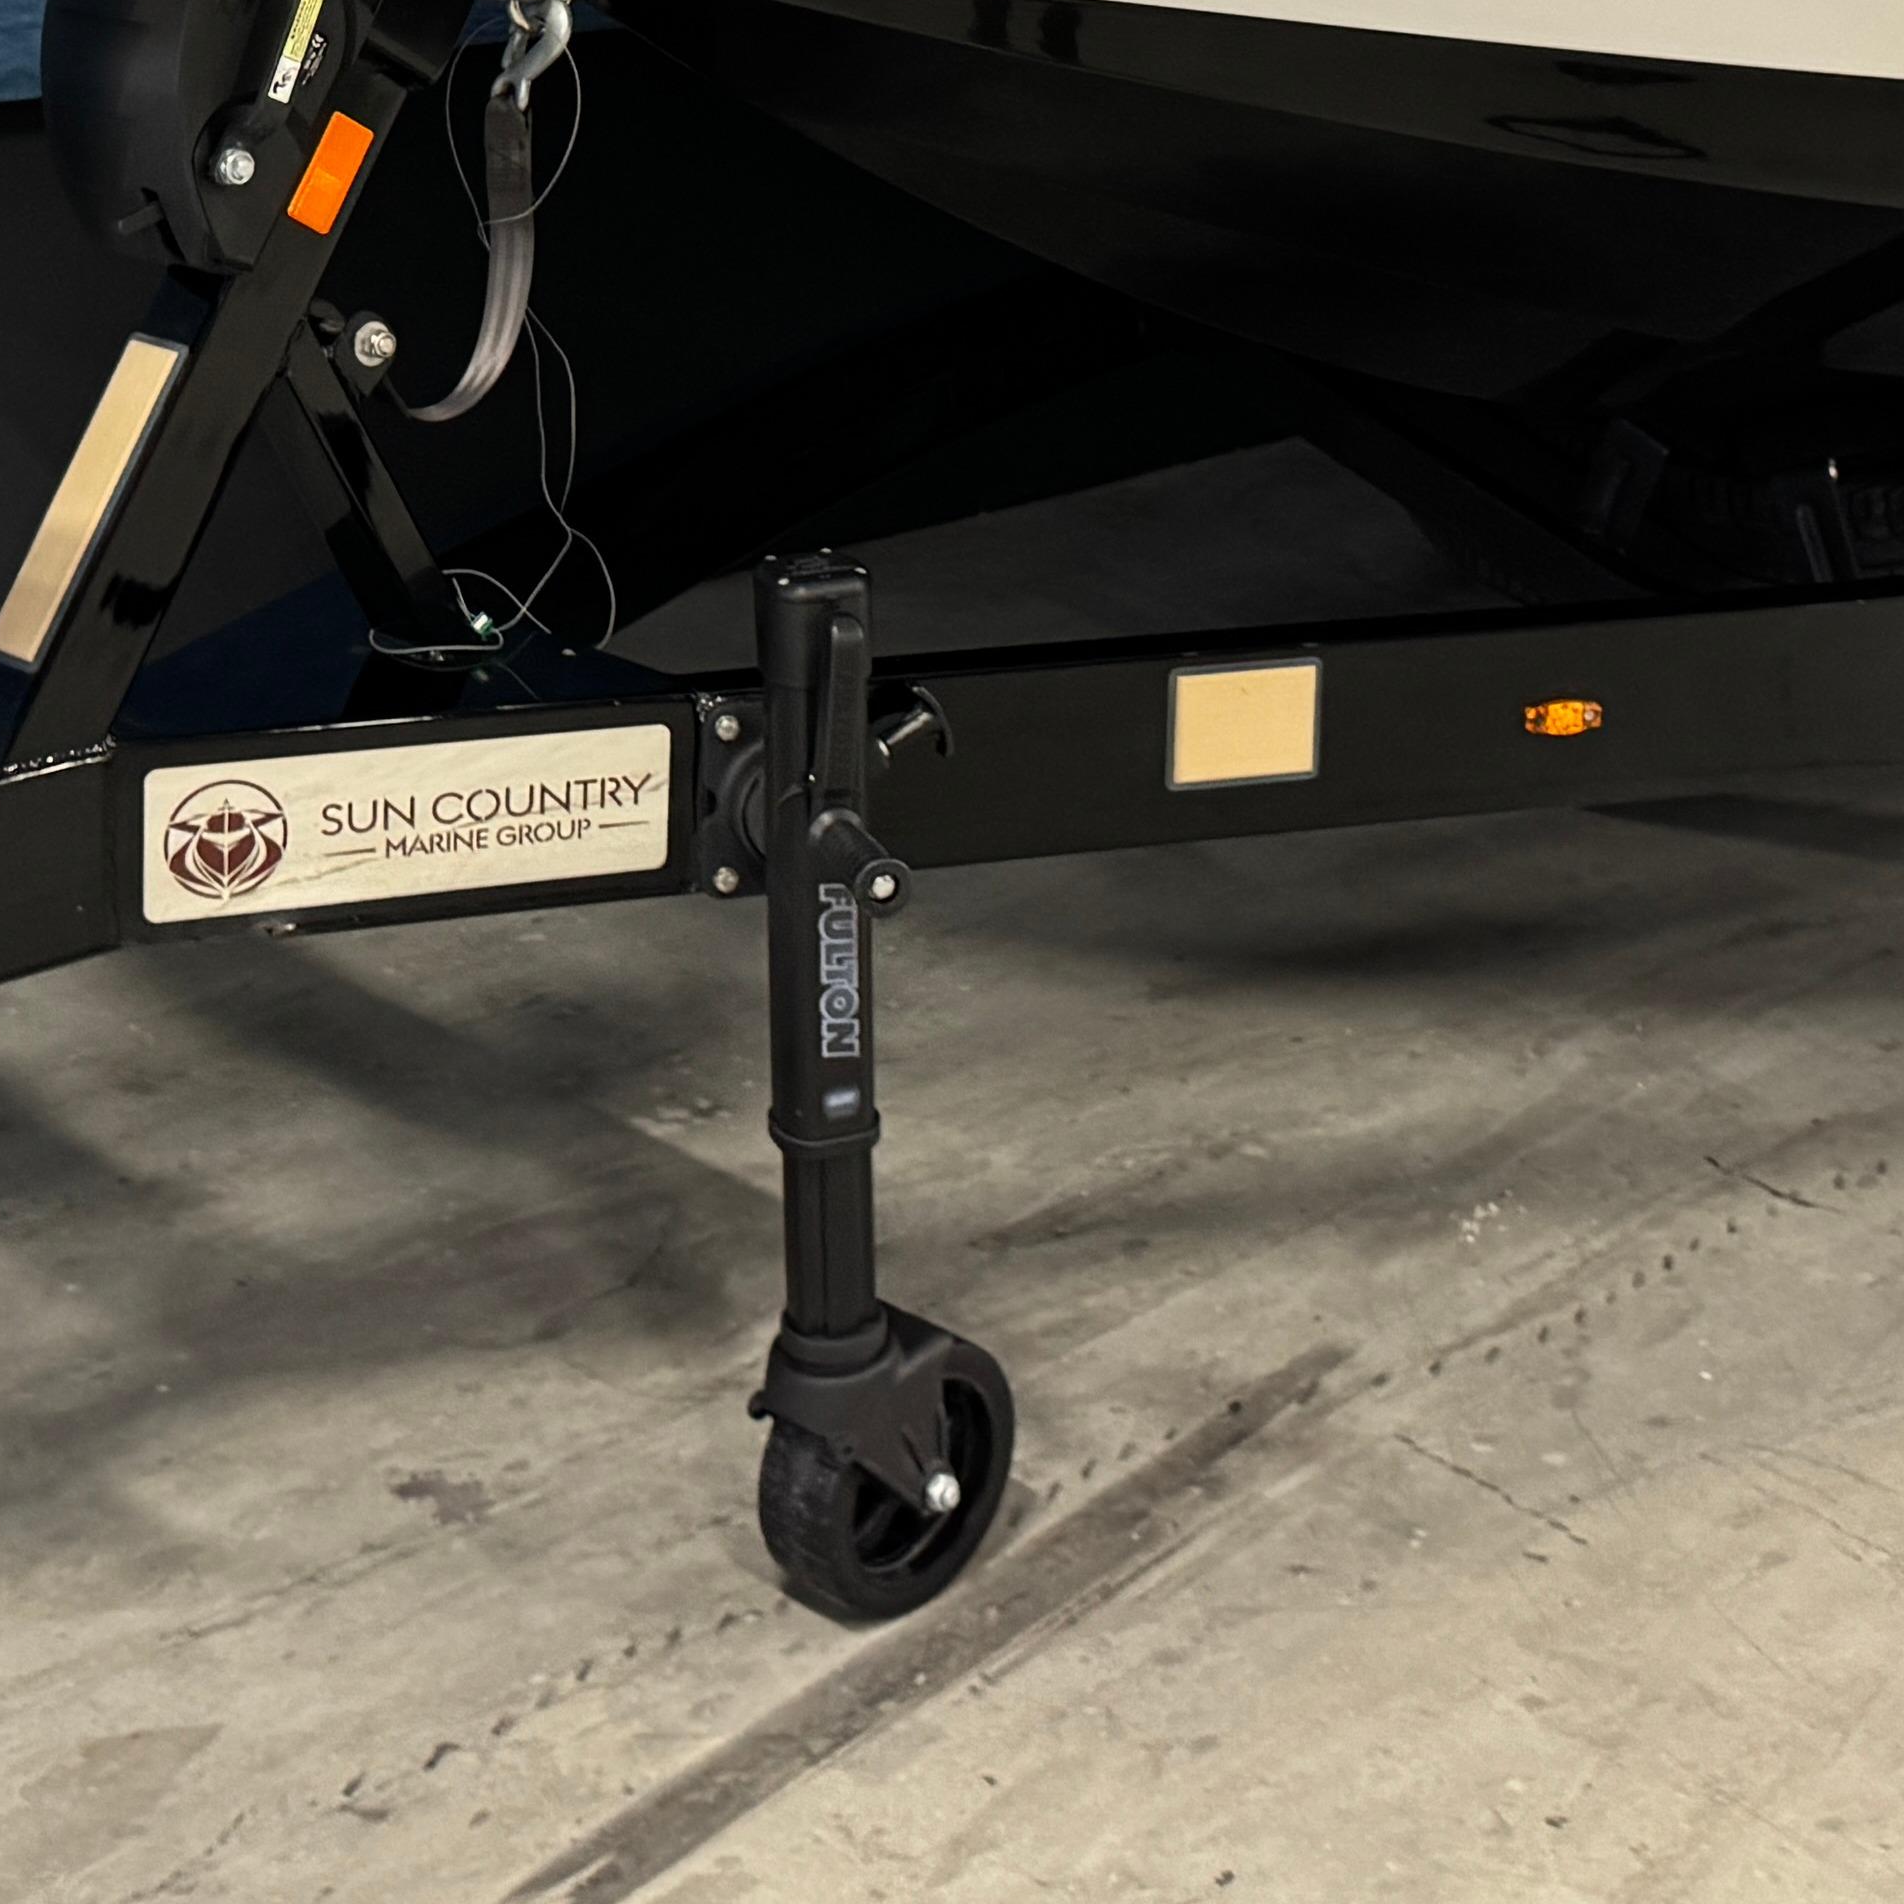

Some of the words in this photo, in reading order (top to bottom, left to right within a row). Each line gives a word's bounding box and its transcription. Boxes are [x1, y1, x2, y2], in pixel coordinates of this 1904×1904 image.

[321, 795, 416, 836] SUN
[431, 773, 652, 825] COUNTRY
[385, 828, 489, 859] MARINE
[496, 818, 592, 847] GROUP
[818, 883, 860, 1058] FULTON
